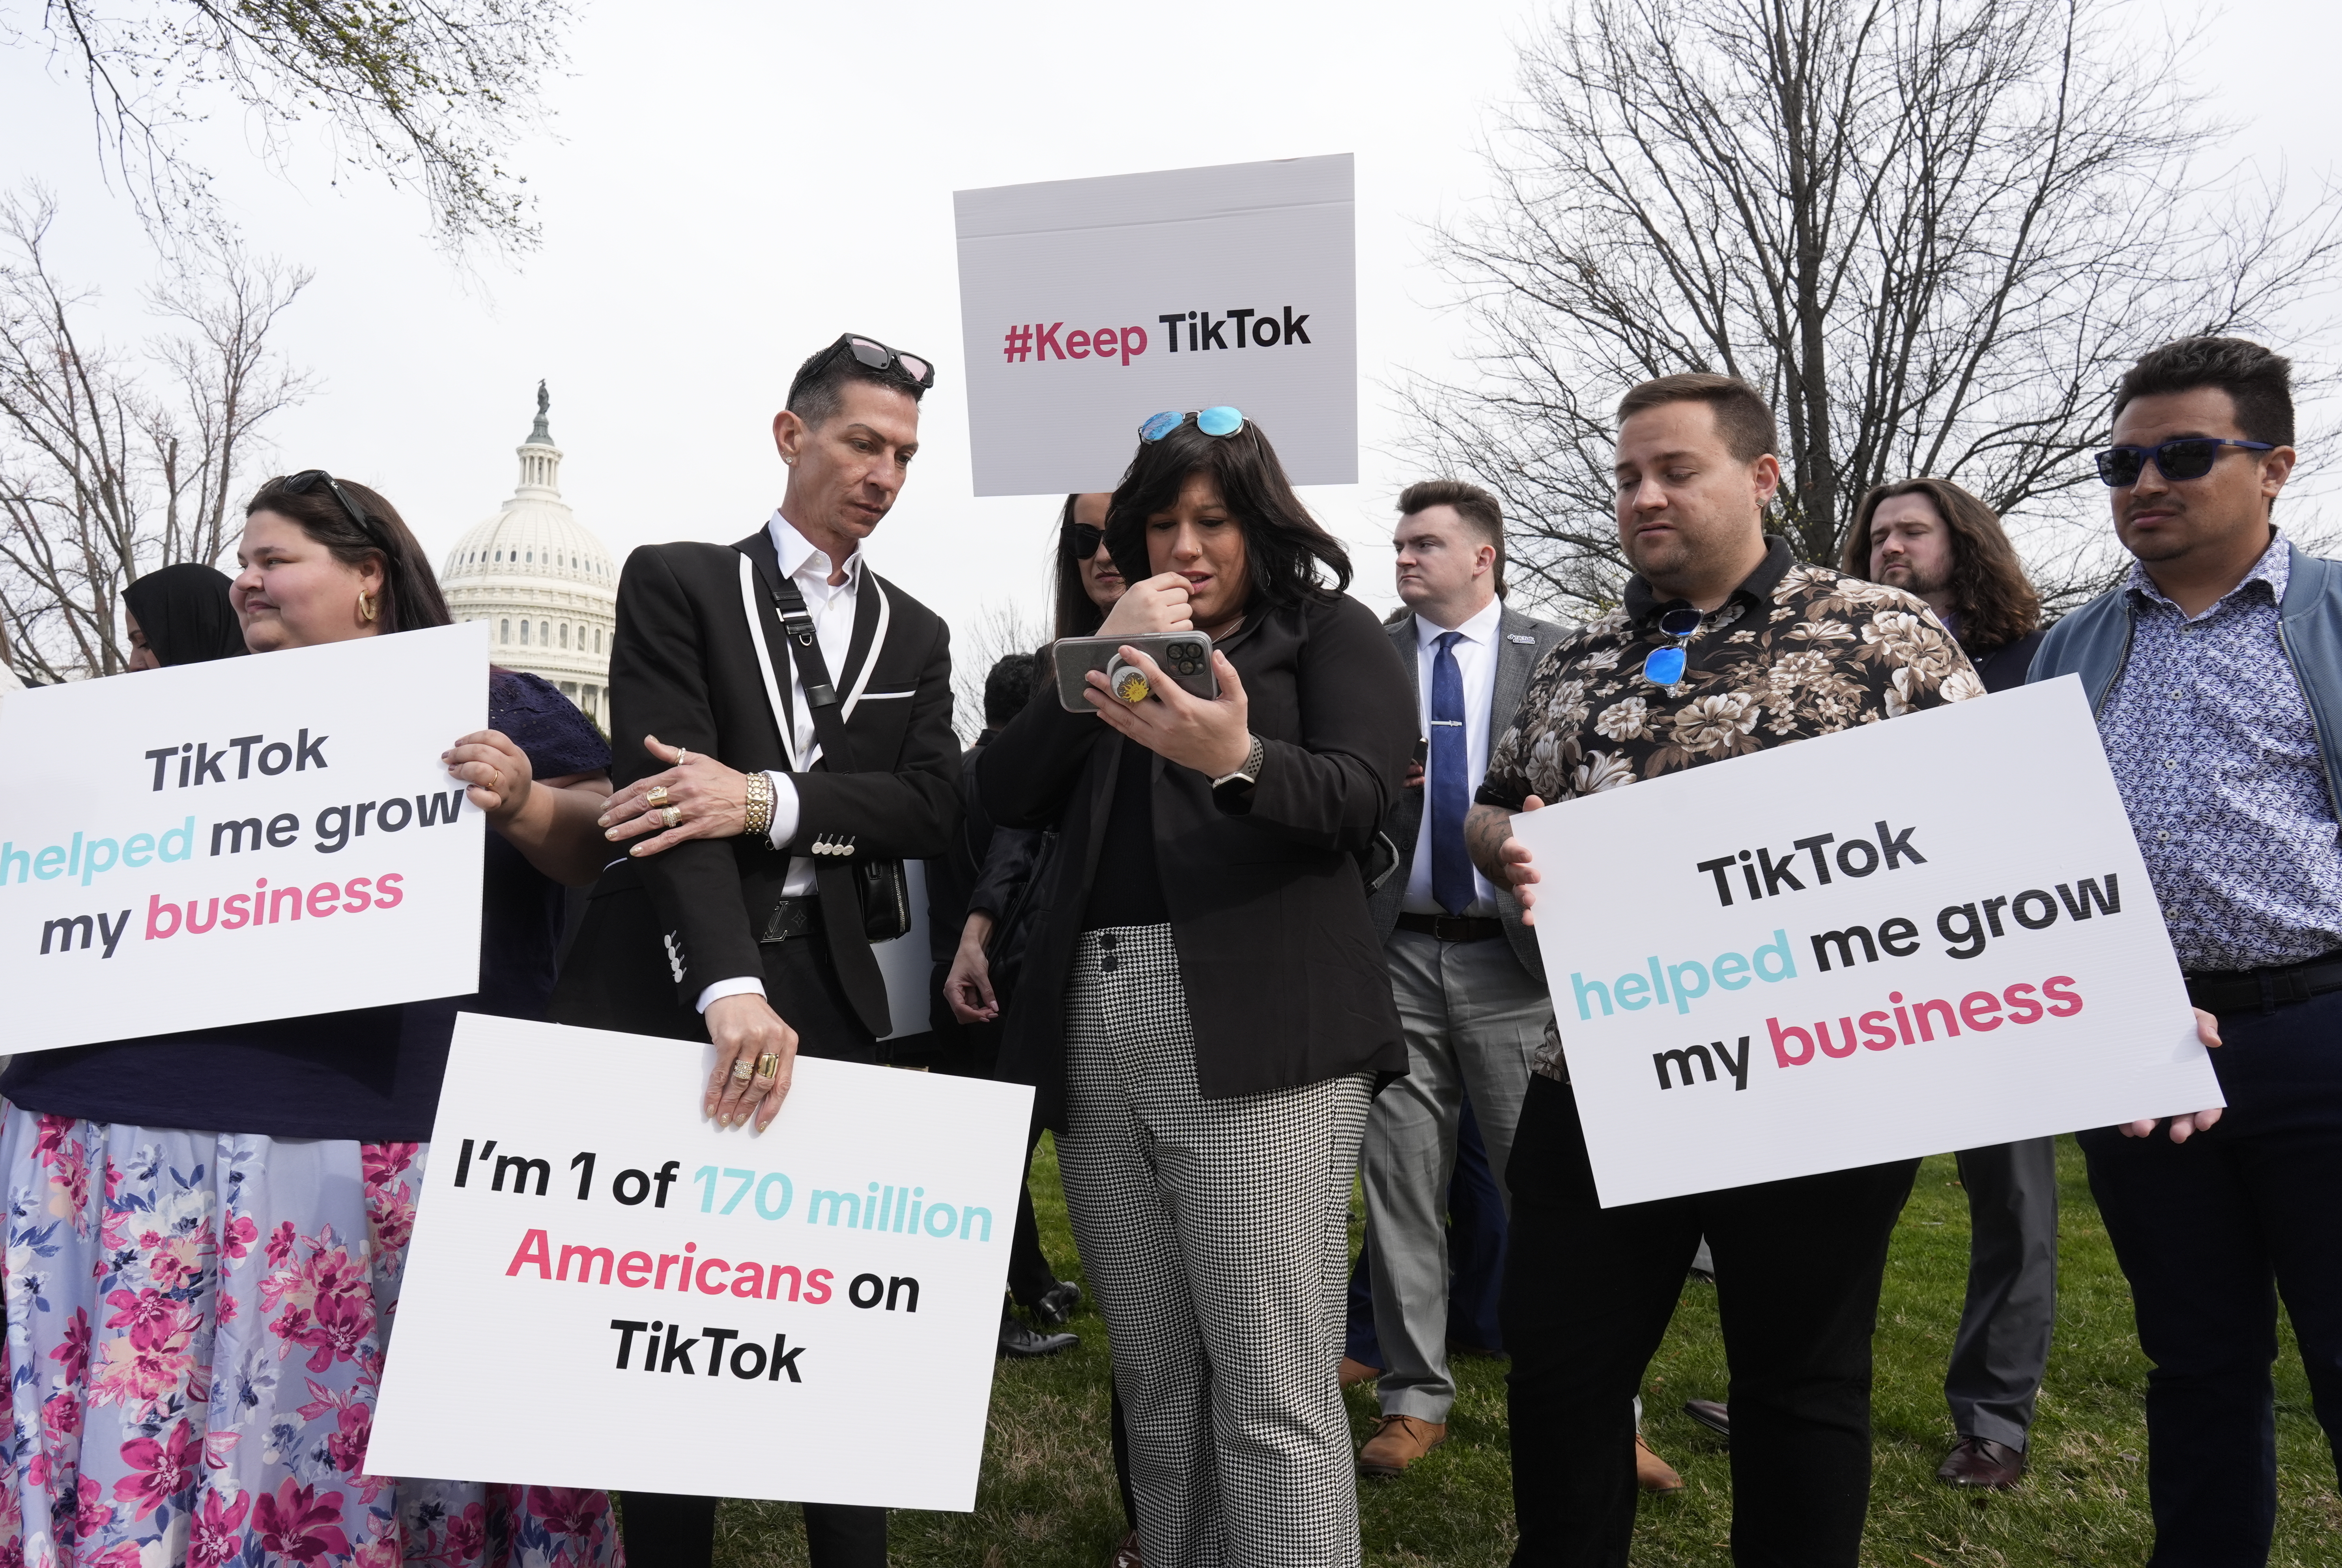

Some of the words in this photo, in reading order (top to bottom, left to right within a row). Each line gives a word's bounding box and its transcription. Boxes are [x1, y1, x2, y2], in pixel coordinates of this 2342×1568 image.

[1004, 322, 1147, 366] #Keep
[1159, 306, 1312, 353] TikTok
[145, 728, 329, 792] TikTok
[0, 816, 195, 886] helped
[210, 813, 299, 856] me
[314, 789, 465, 854] grow
[1697, 820, 1928, 907] TikTok
[40, 909, 132, 959] my
[145, 873, 404, 940] business
[1571, 929, 1798, 1020] helped
[1810, 918, 1920, 972] me
[1937, 873, 2121, 959] grow
[1652, 1035, 1750, 1091] my
[1766, 975, 2083, 1068] business
[454, 1139, 550, 1196] I'm
[570, 1152, 596, 1200] 1
[613, 1161, 680, 1208] of
[694, 1166, 793, 1220] 170
[807, 1182, 992, 1242] million
[505, 1229, 834, 1304] Americans
[849, 1273, 919, 1313] on
[610, 1319, 807, 1383] TikTok
